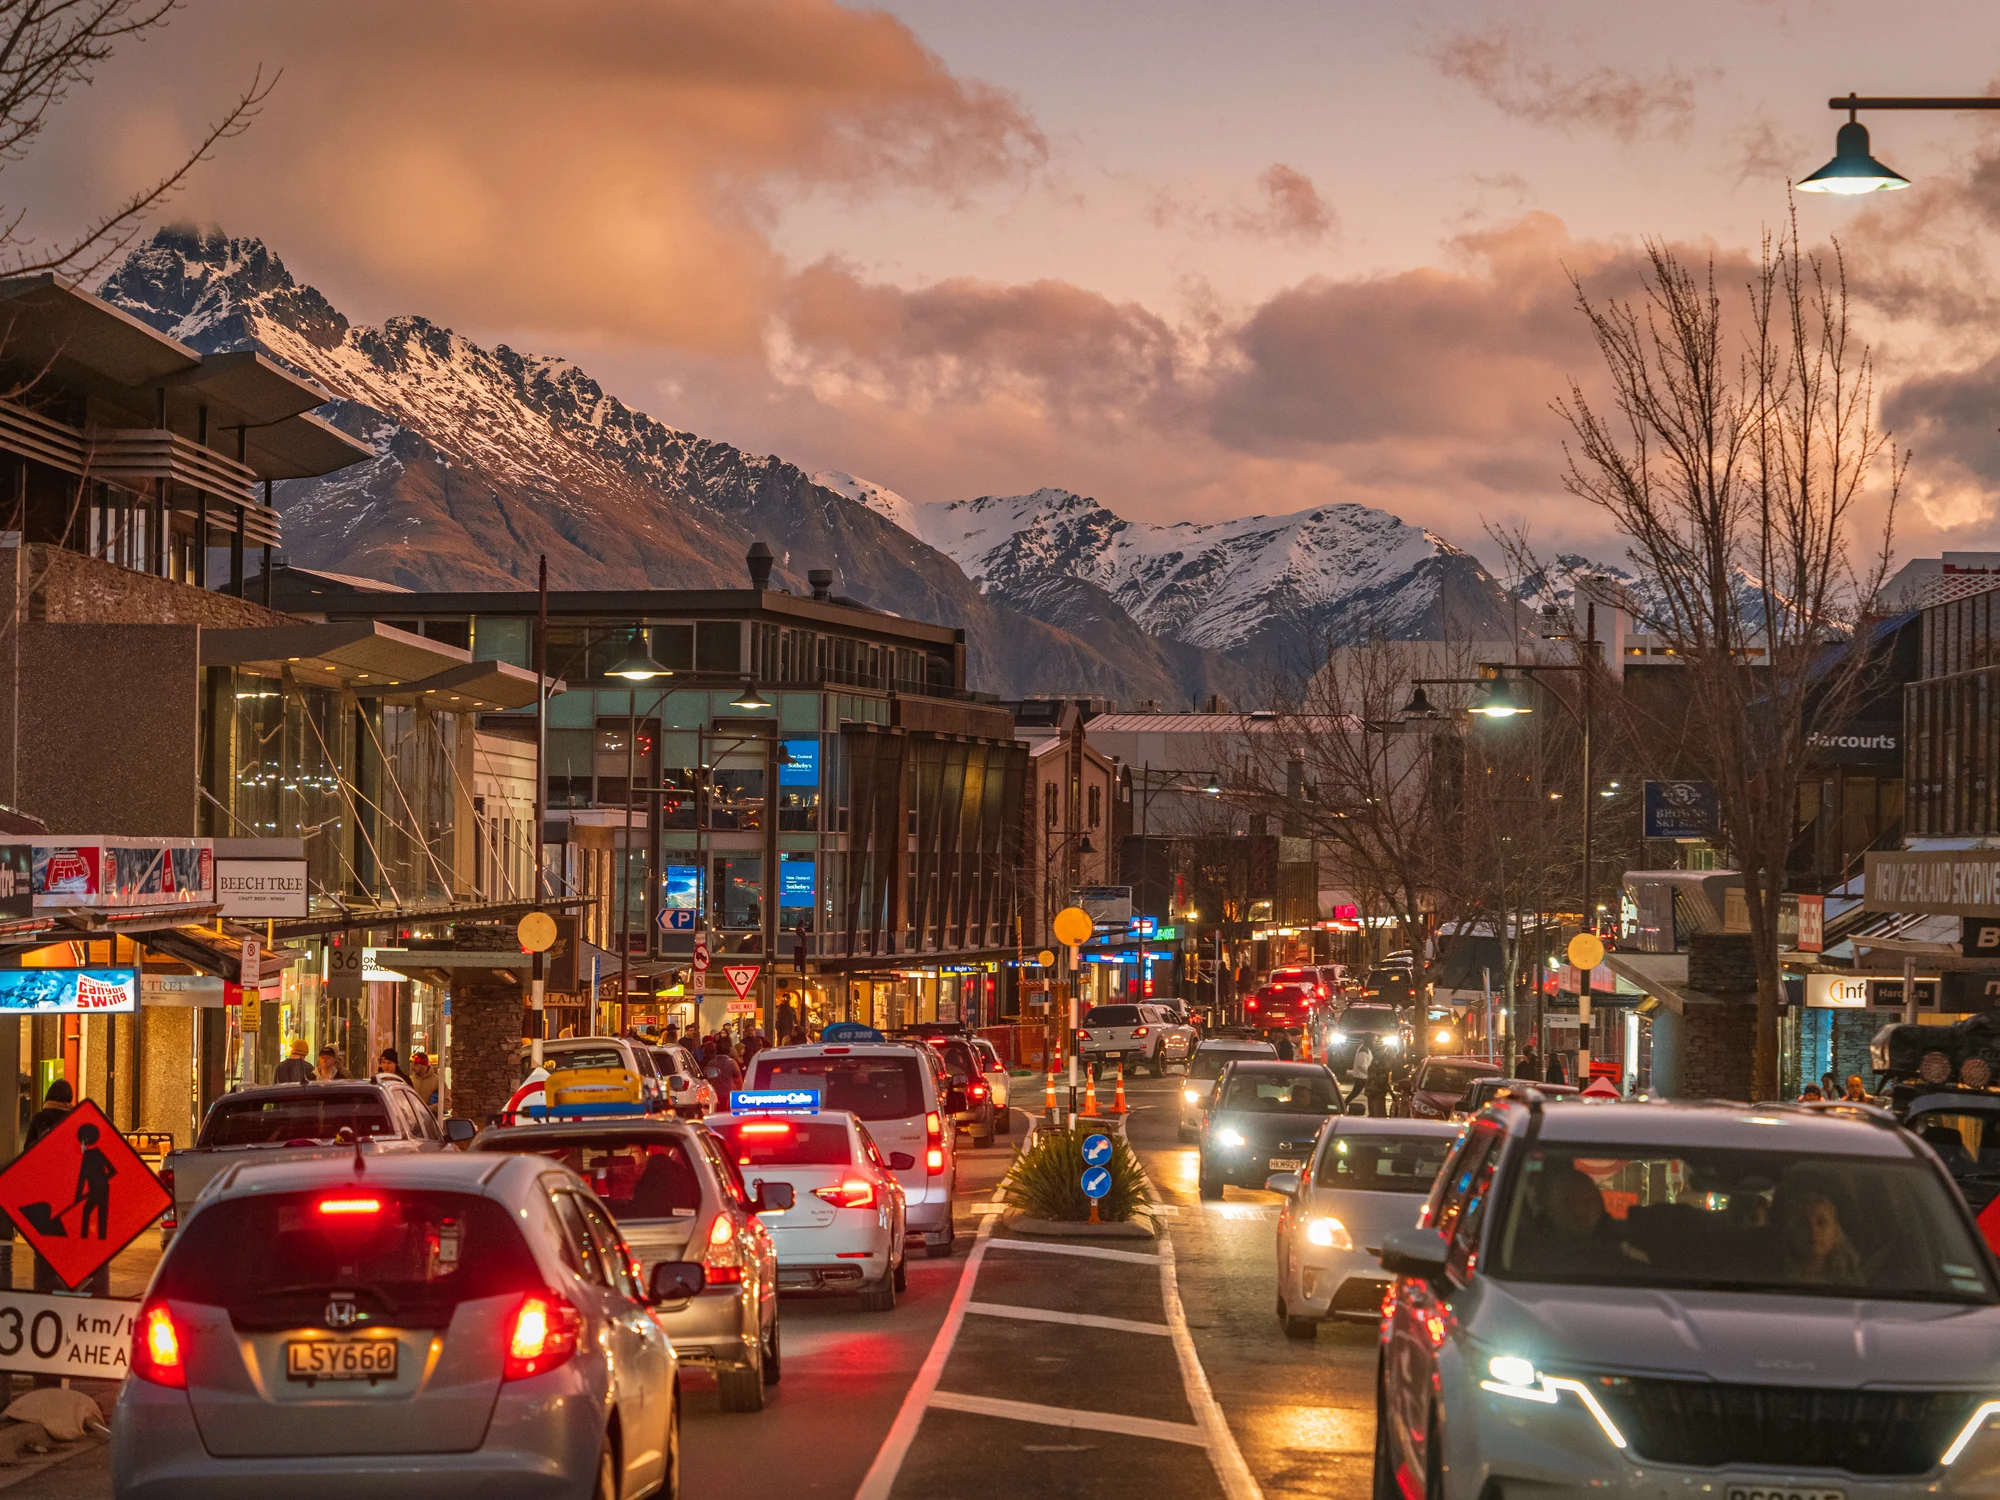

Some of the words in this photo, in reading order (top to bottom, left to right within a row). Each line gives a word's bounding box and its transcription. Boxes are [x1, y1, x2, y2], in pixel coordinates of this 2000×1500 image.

[1806, 732, 1897, 749] Harcourts
[220, 877, 265, 890] BEECH
[268, 877, 303, 890] TREE
[1875, 864, 1900, 901] NEW
[1901, 864, 1952, 903] ZEALAND
[1953, 863, 2000, 905] SKYDIVE
[678, 912, 690, 927] P
[332, 951, 358, 970] 36
[80, 976, 110, 987] SHOTOVER
[151, 980, 186, 992] TREE
[529, 994, 584, 1004] LATO
[1838, 982, 1867, 1000] inf
[1879, 988, 1929, 998] Harcts
[738, 1094, 787, 1106] Corporate
[0, 1307, 63, 1359] 30
[68, 1344, 127, 1366] AHEA
[294, 1346, 391, 1371] LSY660
